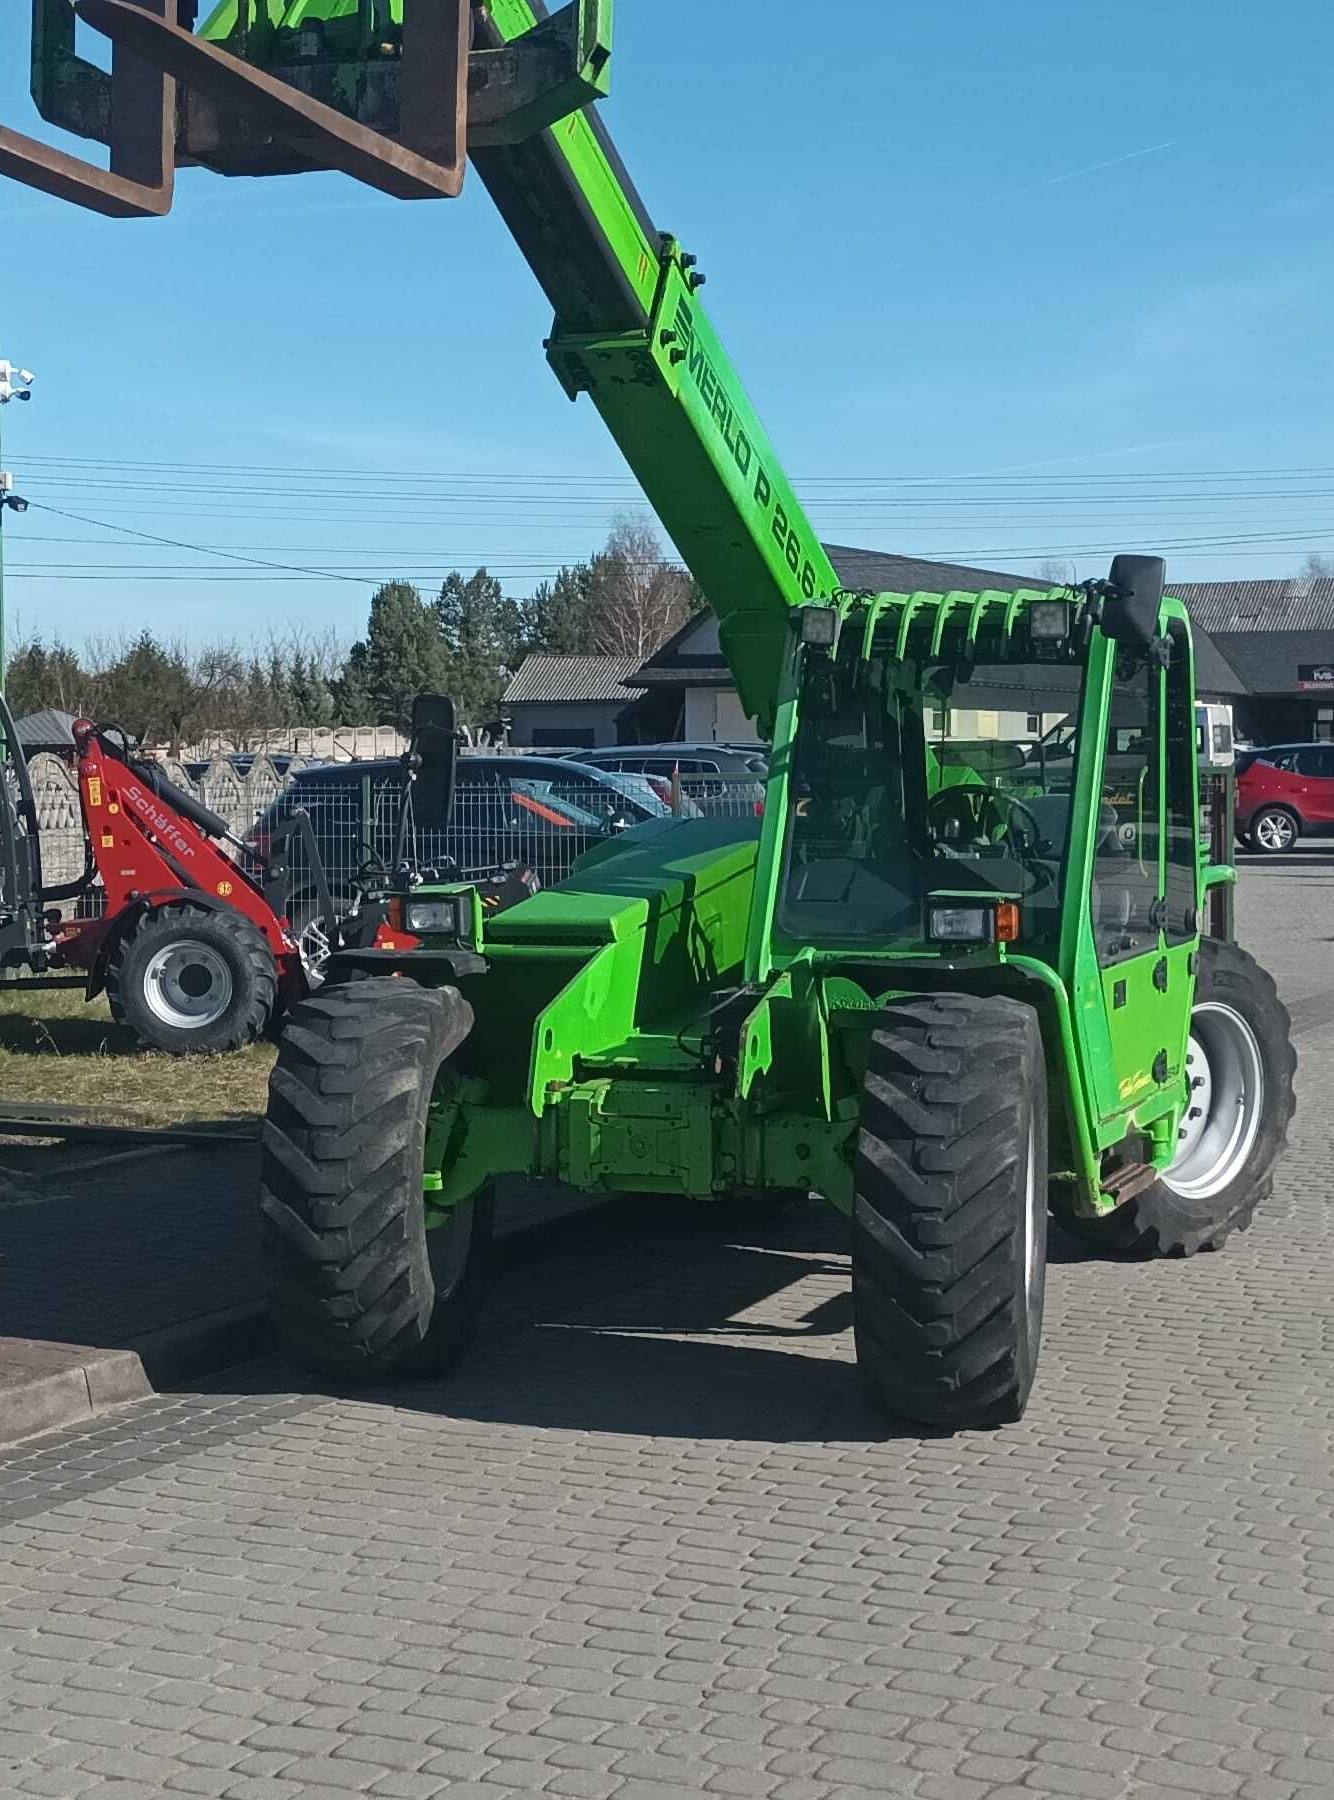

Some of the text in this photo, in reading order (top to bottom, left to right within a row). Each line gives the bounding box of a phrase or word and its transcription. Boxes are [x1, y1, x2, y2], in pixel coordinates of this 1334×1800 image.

[686, 327, 816, 599] MERLO P 26.6
[122, 786, 196, 857] Schäffer
